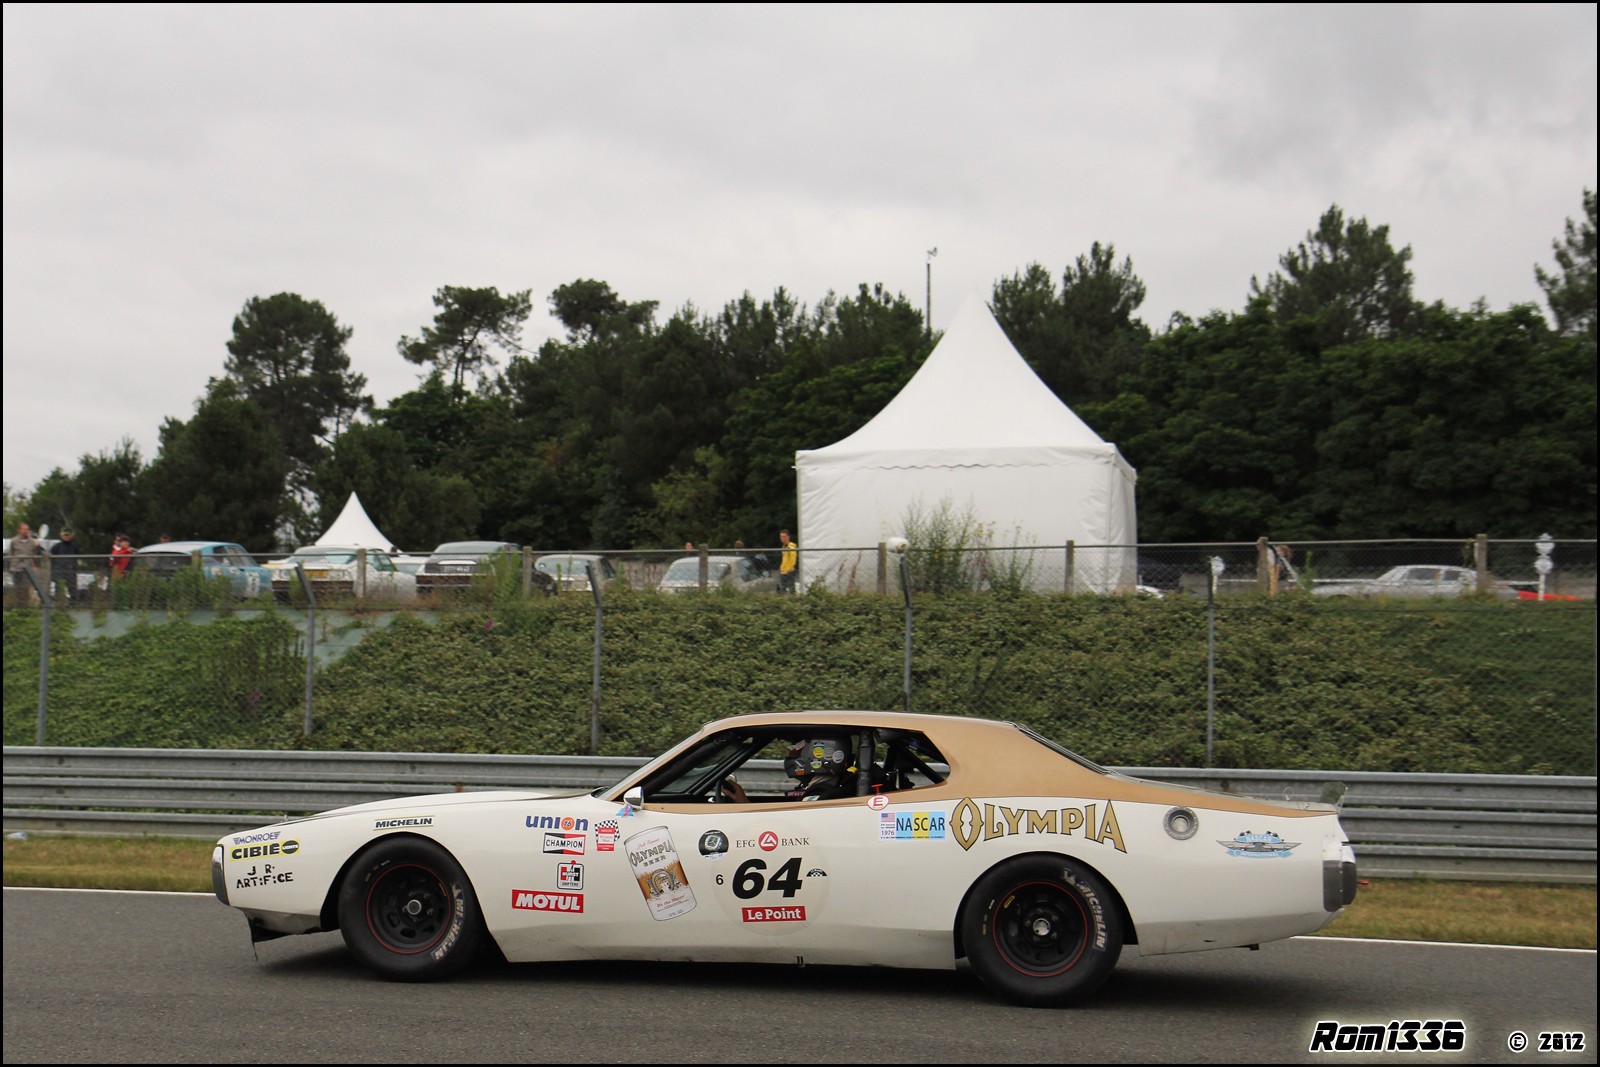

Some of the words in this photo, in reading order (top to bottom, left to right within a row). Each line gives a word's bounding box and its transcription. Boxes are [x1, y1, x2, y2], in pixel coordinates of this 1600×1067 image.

[873, 797, 884, 807] E
[375, 818, 432, 828] MICHELIN
[896, 817, 945, 832] NASCAR
[949, 797, 1127, 854] OLYMPIA
[237, 832, 276, 844] MONROE
[546, 839, 583, 848] CHAMPION
[736, 840, 755, 848] EFG
[781, 838, 810, 846] BANK
[630, 839, 676, 867] OLYMPIA
[716, 874, 724, 885] 6
[732, 857, 803, 899] 64
[515, 893, 581, 911] MOTUL
[748, 909, 763, 920] Le
[765, 908, 802, 920] Point
